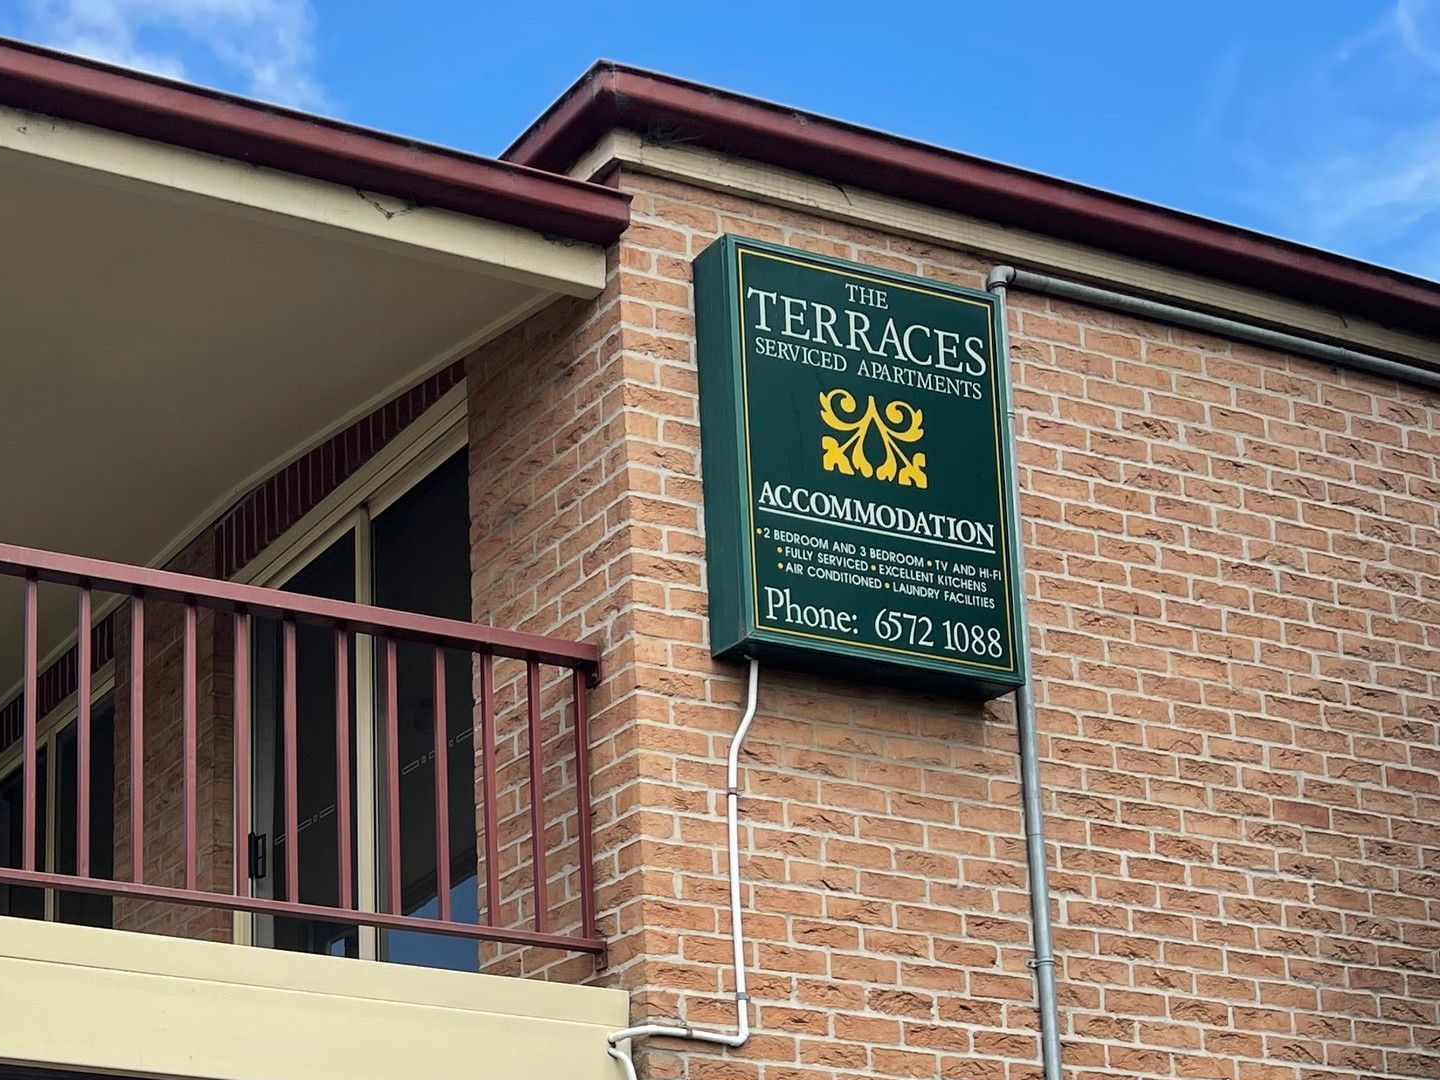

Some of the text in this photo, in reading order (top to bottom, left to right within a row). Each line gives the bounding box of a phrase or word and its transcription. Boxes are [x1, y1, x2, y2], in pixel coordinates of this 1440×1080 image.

[844, 283, 888, 310] THE
[747, 286, 987, 377] TERRACES
[755, 337, 982, 400] SERVICED APARTMENTS
[758, 481, 995, 548] ACCOMMODATION
[763, 527, 1001, 581] 2 BEDROOM AND 3 BEDROOM TV AND HI-FI
[785, 546, 987, 593] FULLY SERVICED EXCELLENT KITCHENS
[785, 562, 995, 609] AIR CONDITIONED LAUNDRY FACILITIES
[764, 586, 1003, 658] Phone: 6572 1088
